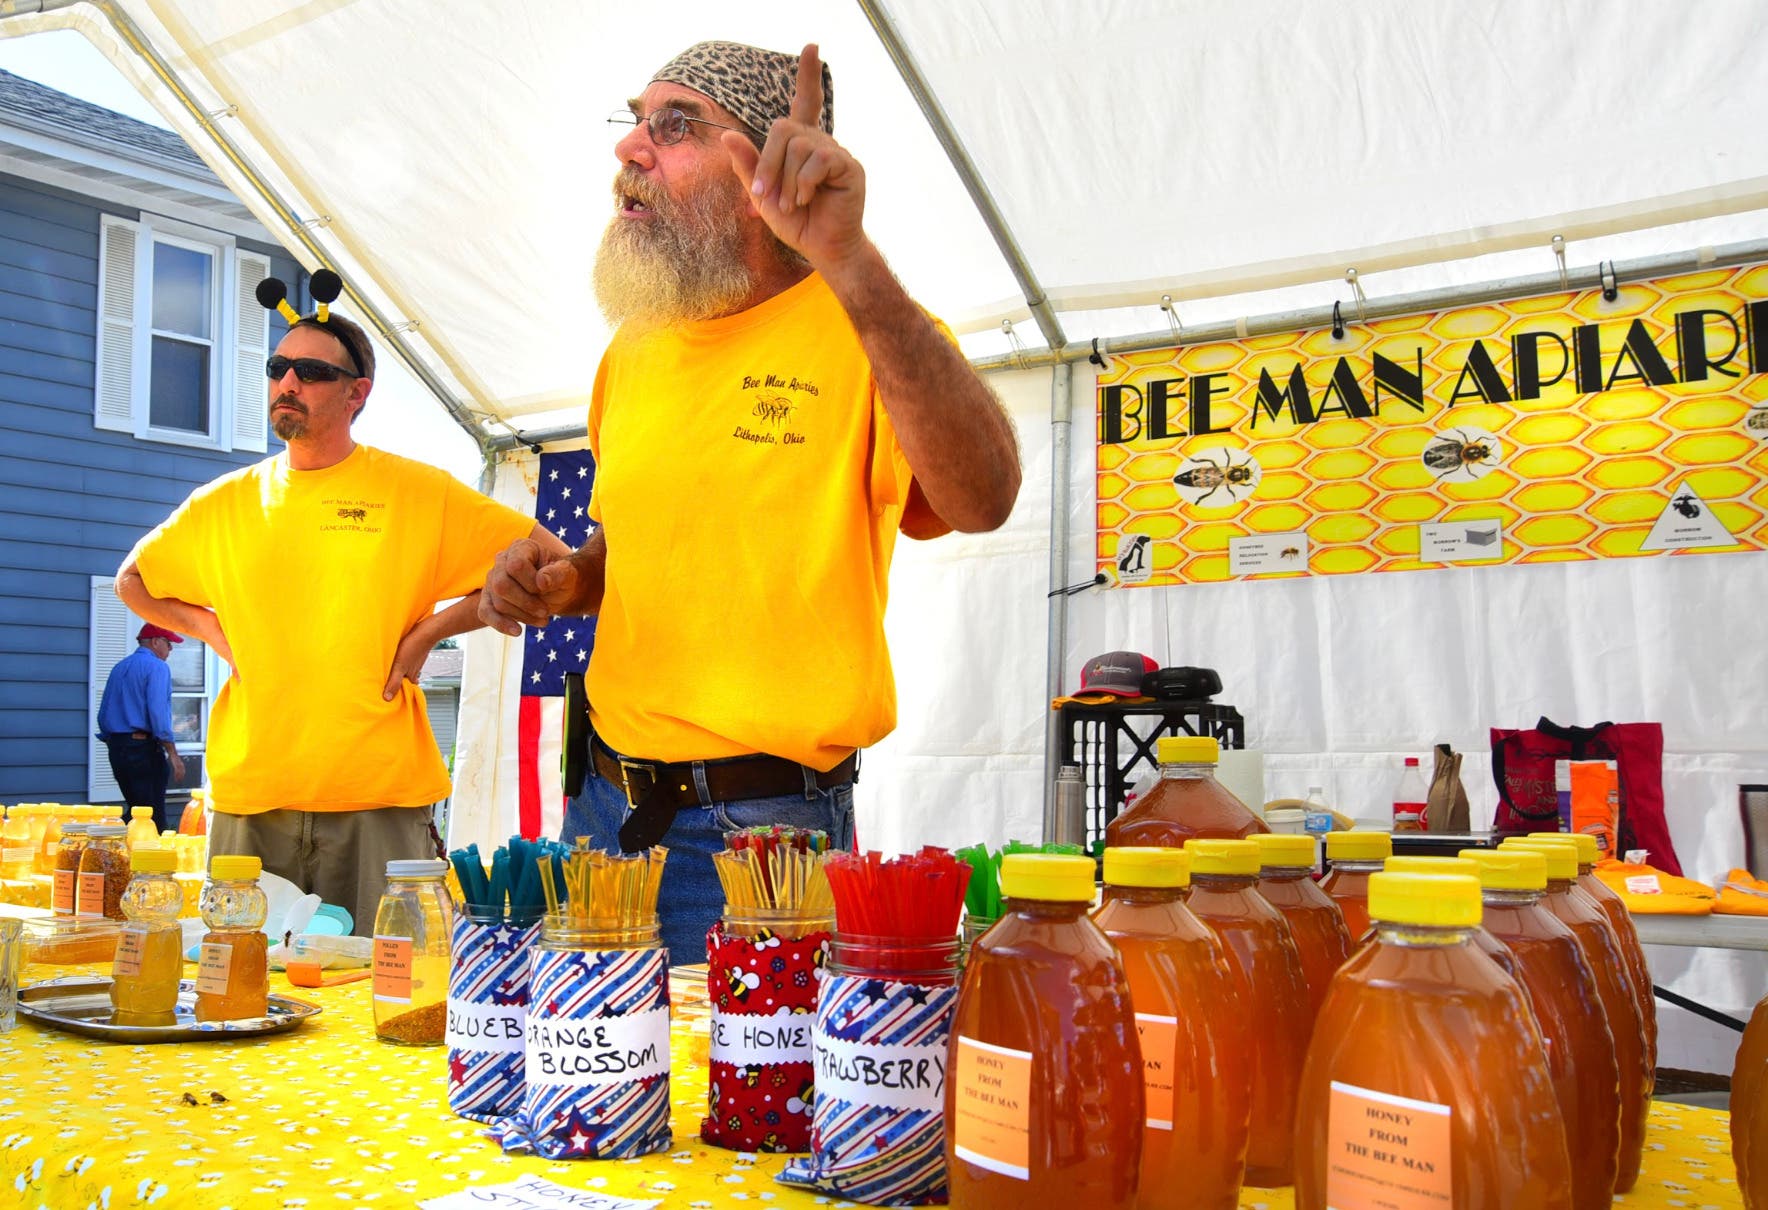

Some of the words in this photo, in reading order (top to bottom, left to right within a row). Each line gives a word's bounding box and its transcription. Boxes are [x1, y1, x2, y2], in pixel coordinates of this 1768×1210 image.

[742, 376, 761, 390] Bee
[764, 374, 786, 388] Man
[1101, 372, 1232, 445] BEE
[1250, 346, 1425, 430] MAN
[783, 432, 806, 445] Ohio
[449, 1010, 523, 1039] BLUEB
[538, 1043, 657, 1075] BLOSSOM
[976, 1055, 1005, 1071] HONEY
[978, 1073, 1002, 1088] FROM
[964, 1087, 978, 1099] THE
[980, 1092, 995, 1103] BEE
[998, 1097, 1019, 1110] MAN
[1366, 1107, 1412, 1125] HONEY
[1369, 1128, 1408, 1147] FROM
[1345, 1141, 1369, 1157] THE
[1373, 1149, 1397, 1164] BEE
[1402, 1157, 1435, 1173] MAN
[469, 1191, 558, 1210] STI
[515, 1181, 636, 1210] HONEY
